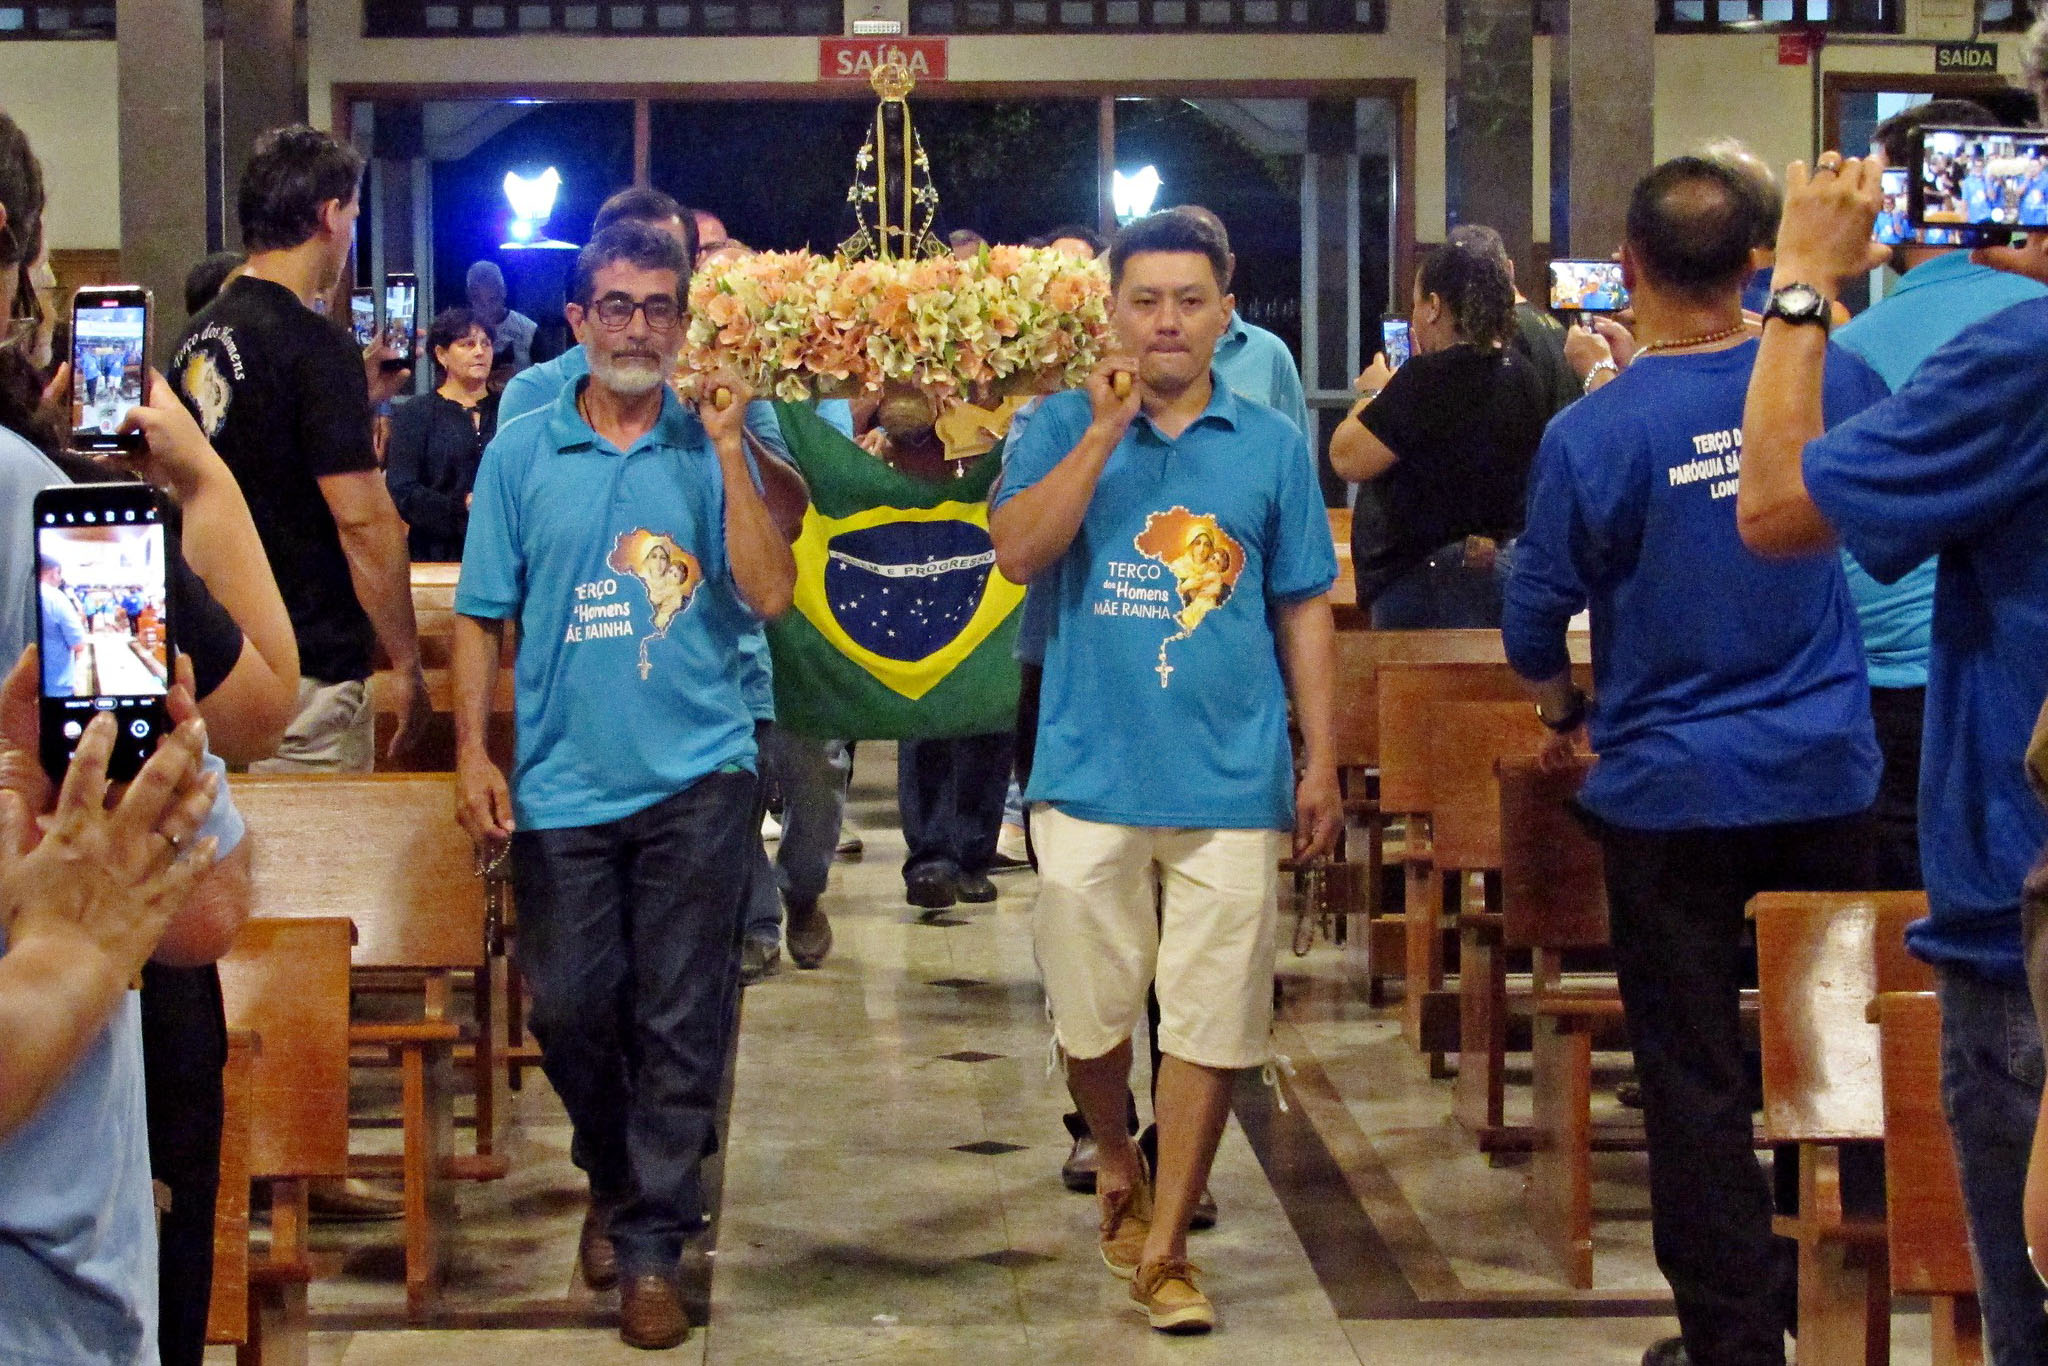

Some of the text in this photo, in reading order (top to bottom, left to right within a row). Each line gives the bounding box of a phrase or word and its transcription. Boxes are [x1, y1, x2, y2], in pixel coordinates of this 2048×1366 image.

[837, 44, 930, 75] SAÍDA
[1939, 46, 1994, 67] SAÍDA
[1692, 430, 1732, 455] TERÇO
[1668, 450, 1742, 487] PARÓQUIA SÃ
[887, 568, 895, 576] E
[904, 552, 993, 575] PROGRESSO
[1108, 561, 1161, 582] TERÇO
[1117, 581, 1169, 602] Homens
[579, 601, 630, 623] Homens
[1094, 599, 1171, 620] MÃE RAINHA
